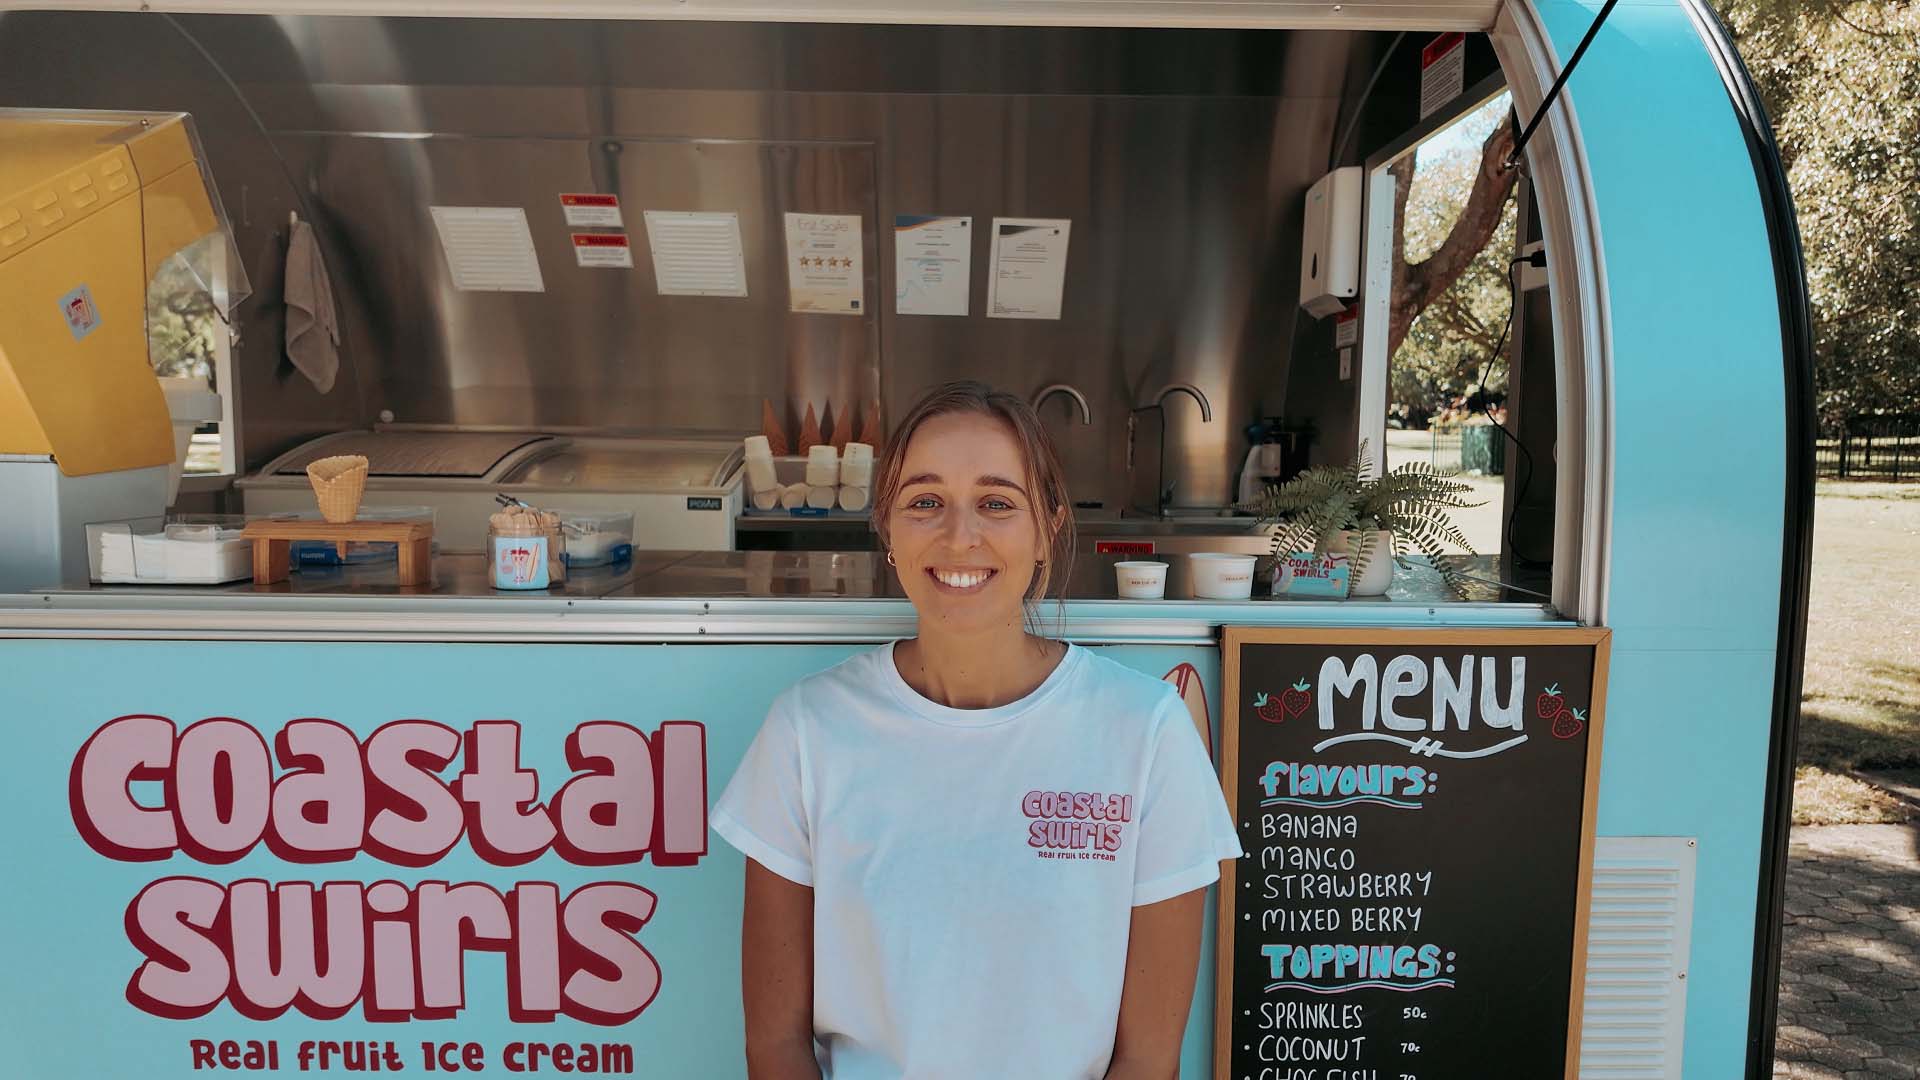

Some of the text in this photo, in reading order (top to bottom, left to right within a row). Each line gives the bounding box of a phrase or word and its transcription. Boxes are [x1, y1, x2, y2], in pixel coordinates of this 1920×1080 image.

[1038, 851, 1055, 859] Real
[1262, 907, 1422, 932] MIXED BERRY
[1261, 943, 1457, 979] TOPPINGS:
[1258, 1002, 1364, 1030] SPRINKLES
[190, 1040, 279, 1070] Real
[298, 1041, 404, 1071] fruit
[1258, 1034, 1366, 1062] COCONUT
